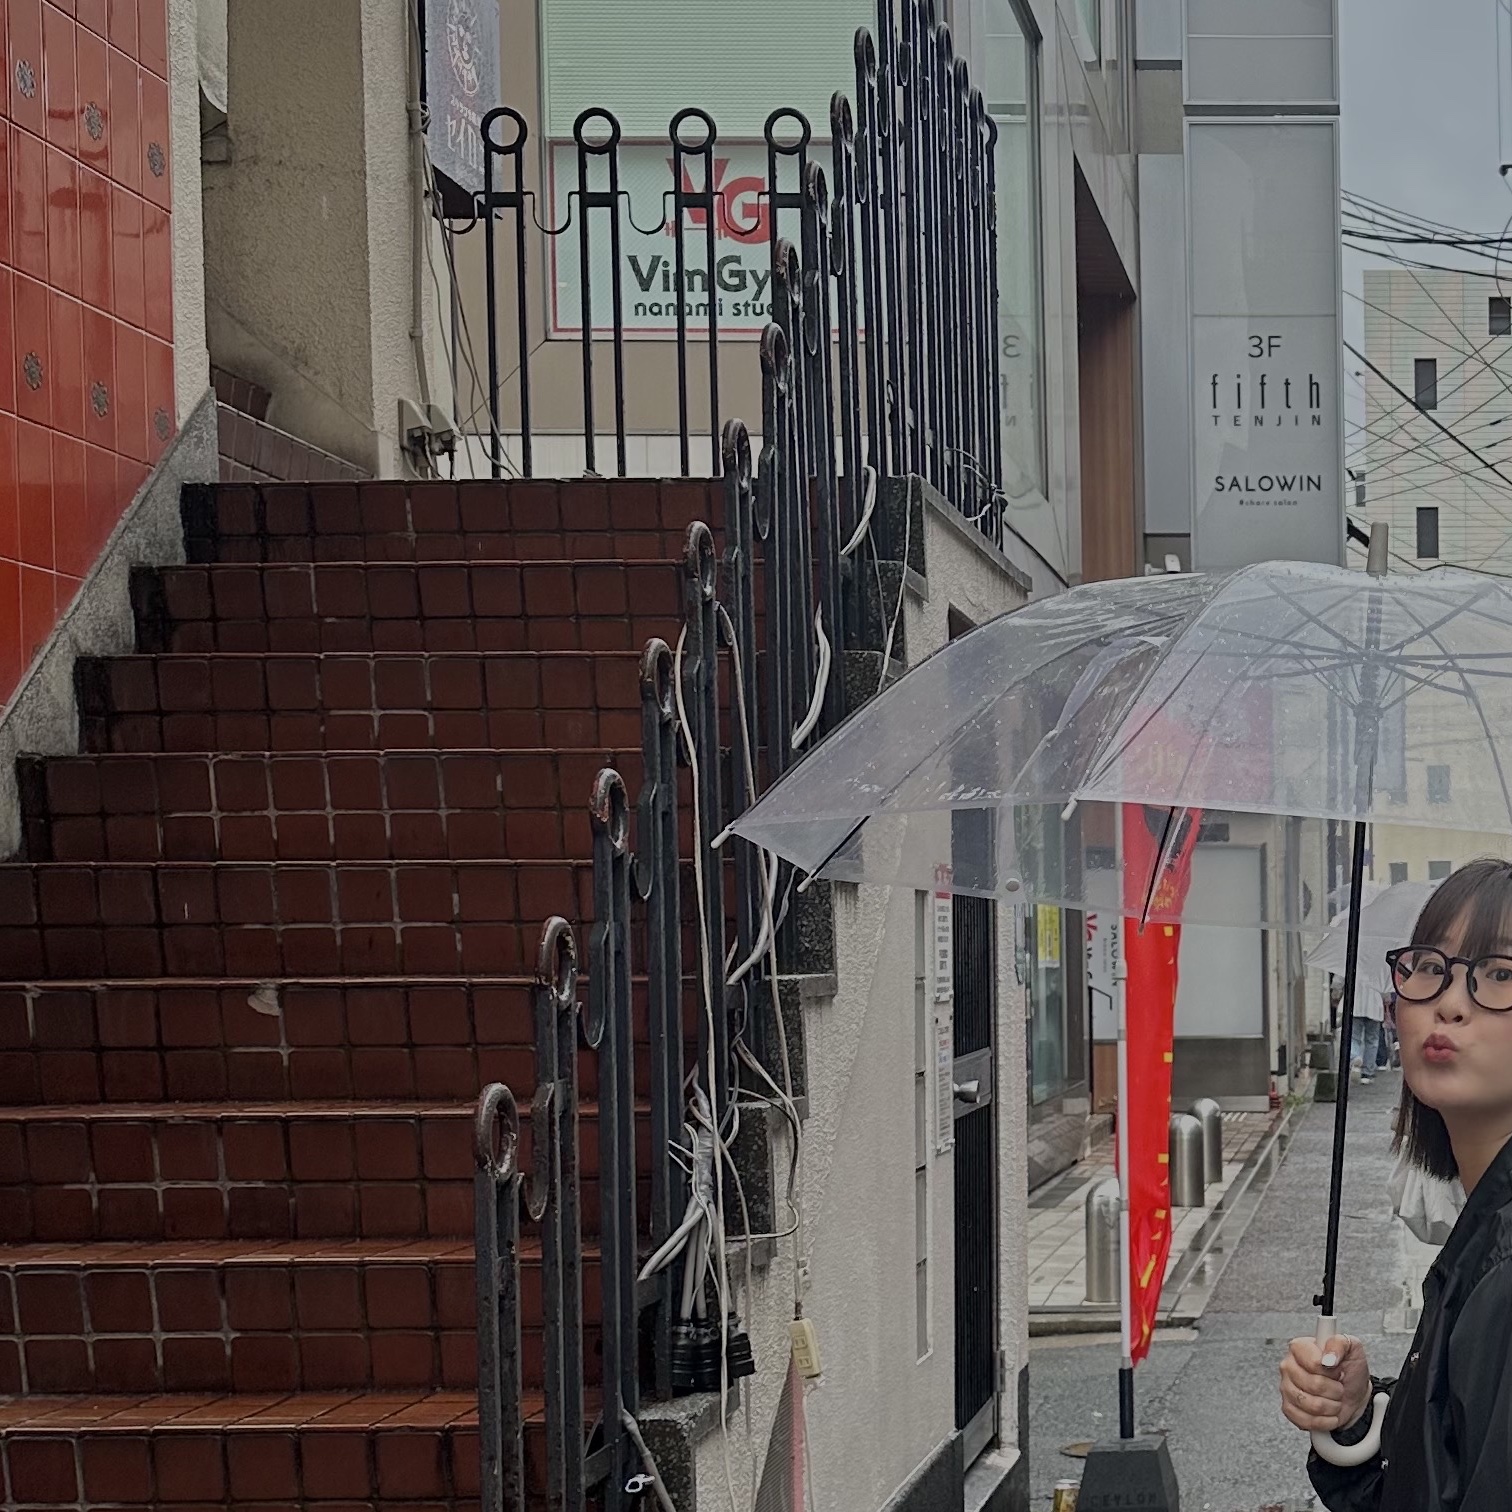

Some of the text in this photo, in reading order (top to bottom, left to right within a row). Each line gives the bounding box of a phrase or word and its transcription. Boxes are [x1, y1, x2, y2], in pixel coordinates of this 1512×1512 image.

[445, 113, 485, 176] セイロ
[626, 254, 772, 301] VimGy
[732, 299, 773, 317] stu
[1247, 335, 1283, 359] 3F
[1210, 373, 1321, 410] fifth
[1211, 414, 1321, 427] TENJIN
[1214, 474, 1322, 493] SALOWIN
